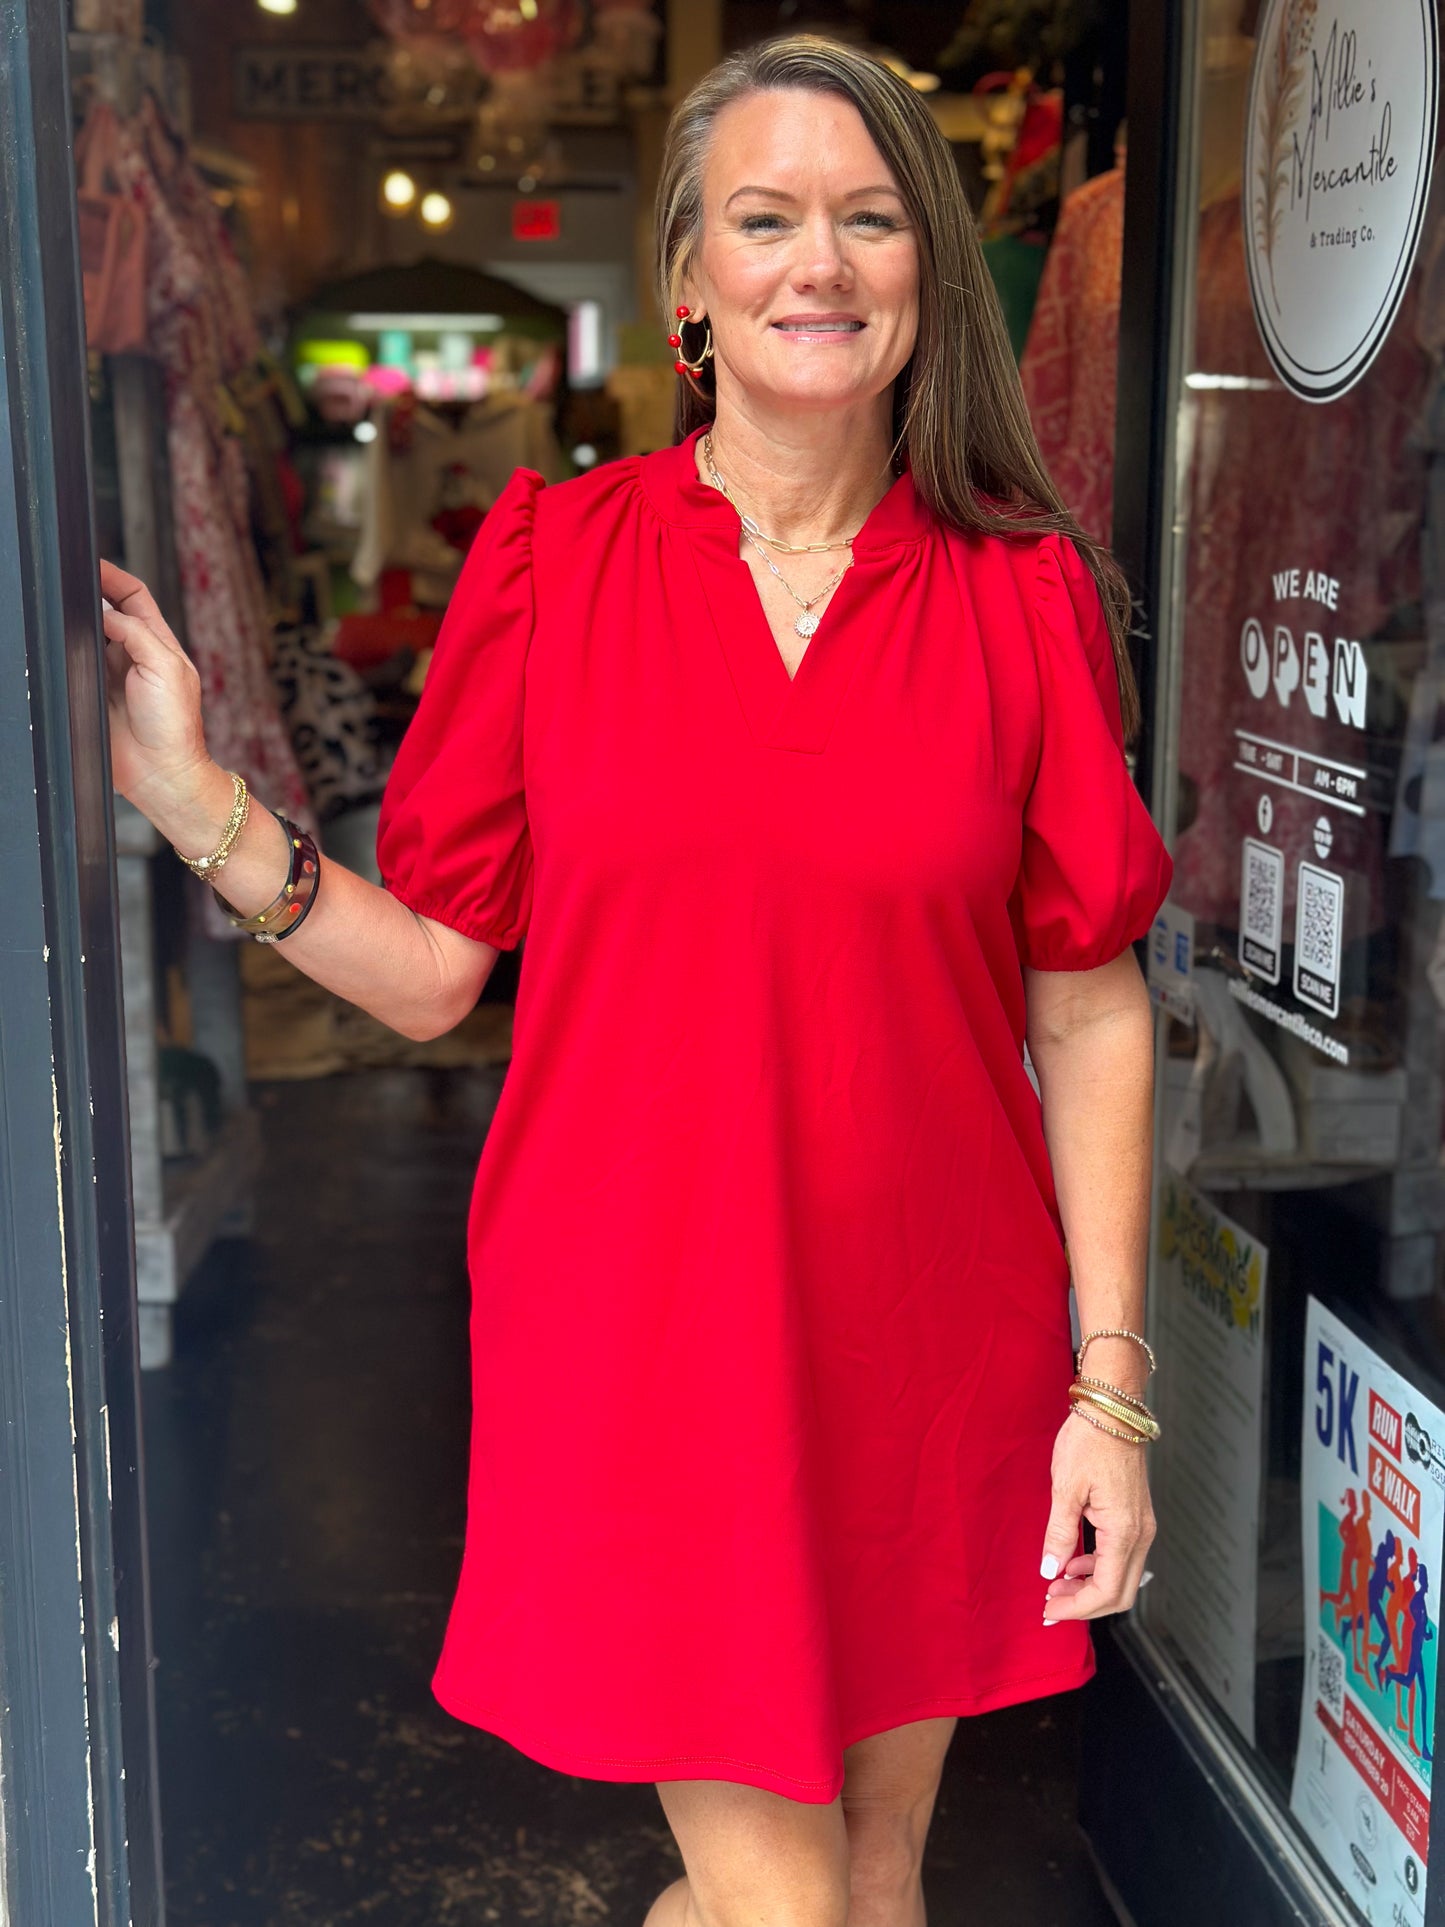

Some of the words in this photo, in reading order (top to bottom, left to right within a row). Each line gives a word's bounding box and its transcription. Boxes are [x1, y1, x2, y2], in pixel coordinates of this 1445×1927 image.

[1311, 19, 1376, 141] Millie's
[1291, 102, 1398, 222] Mercantile
[1310, 233, 1317, 248] &
[1320, 228, 1357, 248] Trading
[1360, 226, 1376, 243] Co.
[1273, 569, 1300, 602] WE
[1303, 570, 1340, 611] ARE
[1240, 617, 1368, 730] OPEN
[1320, 983, 1332, 1004] ME
[1316, 1339, 1360, 1478] 5K
[1372, 1400, 1399, 1450] RUN
[1372, 1457, 1382, 1490] &
[1383, 1465, 1418, 1524] WALK
